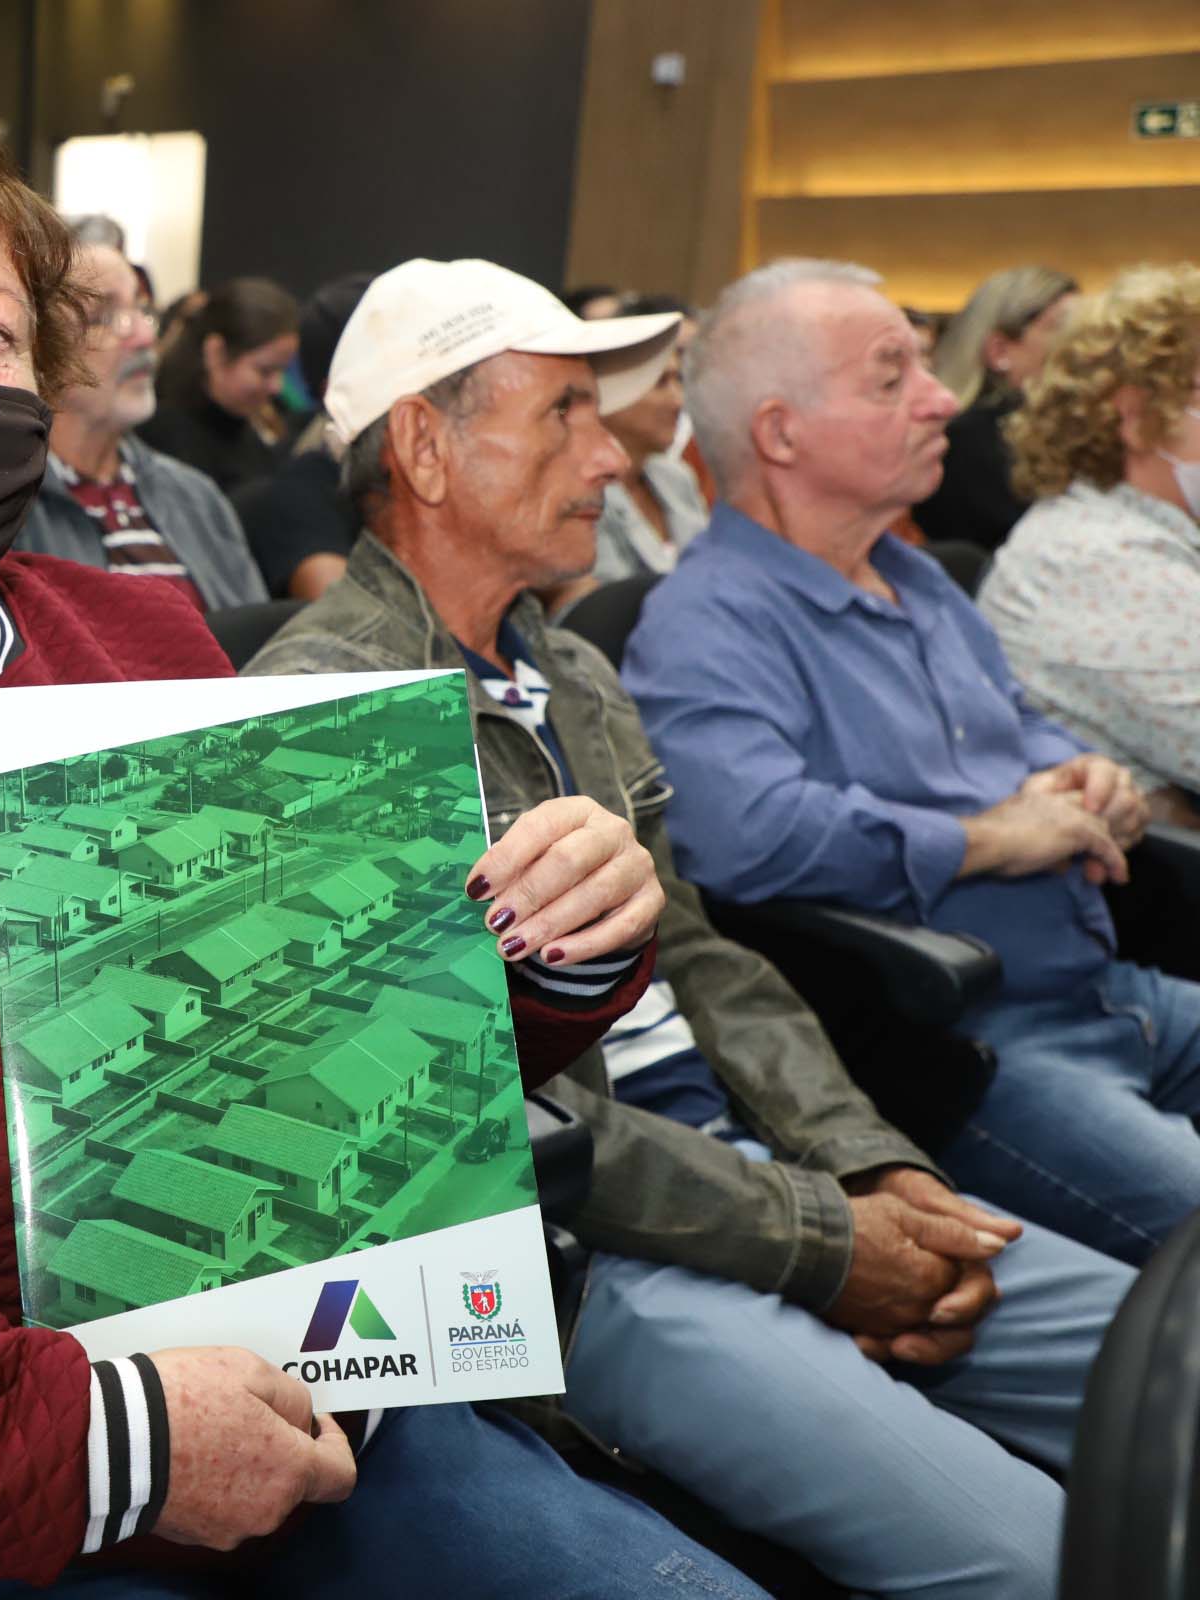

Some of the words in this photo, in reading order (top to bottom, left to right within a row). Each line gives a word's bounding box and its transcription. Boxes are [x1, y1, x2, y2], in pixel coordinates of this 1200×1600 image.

[448, 1318, 525, 1342] PARANÁ
[451, 1343, 527, 1360] GOVERNO
[452, 1361, 473, 1373] DO
[476, 1356, 529, 1371] ESTADO
